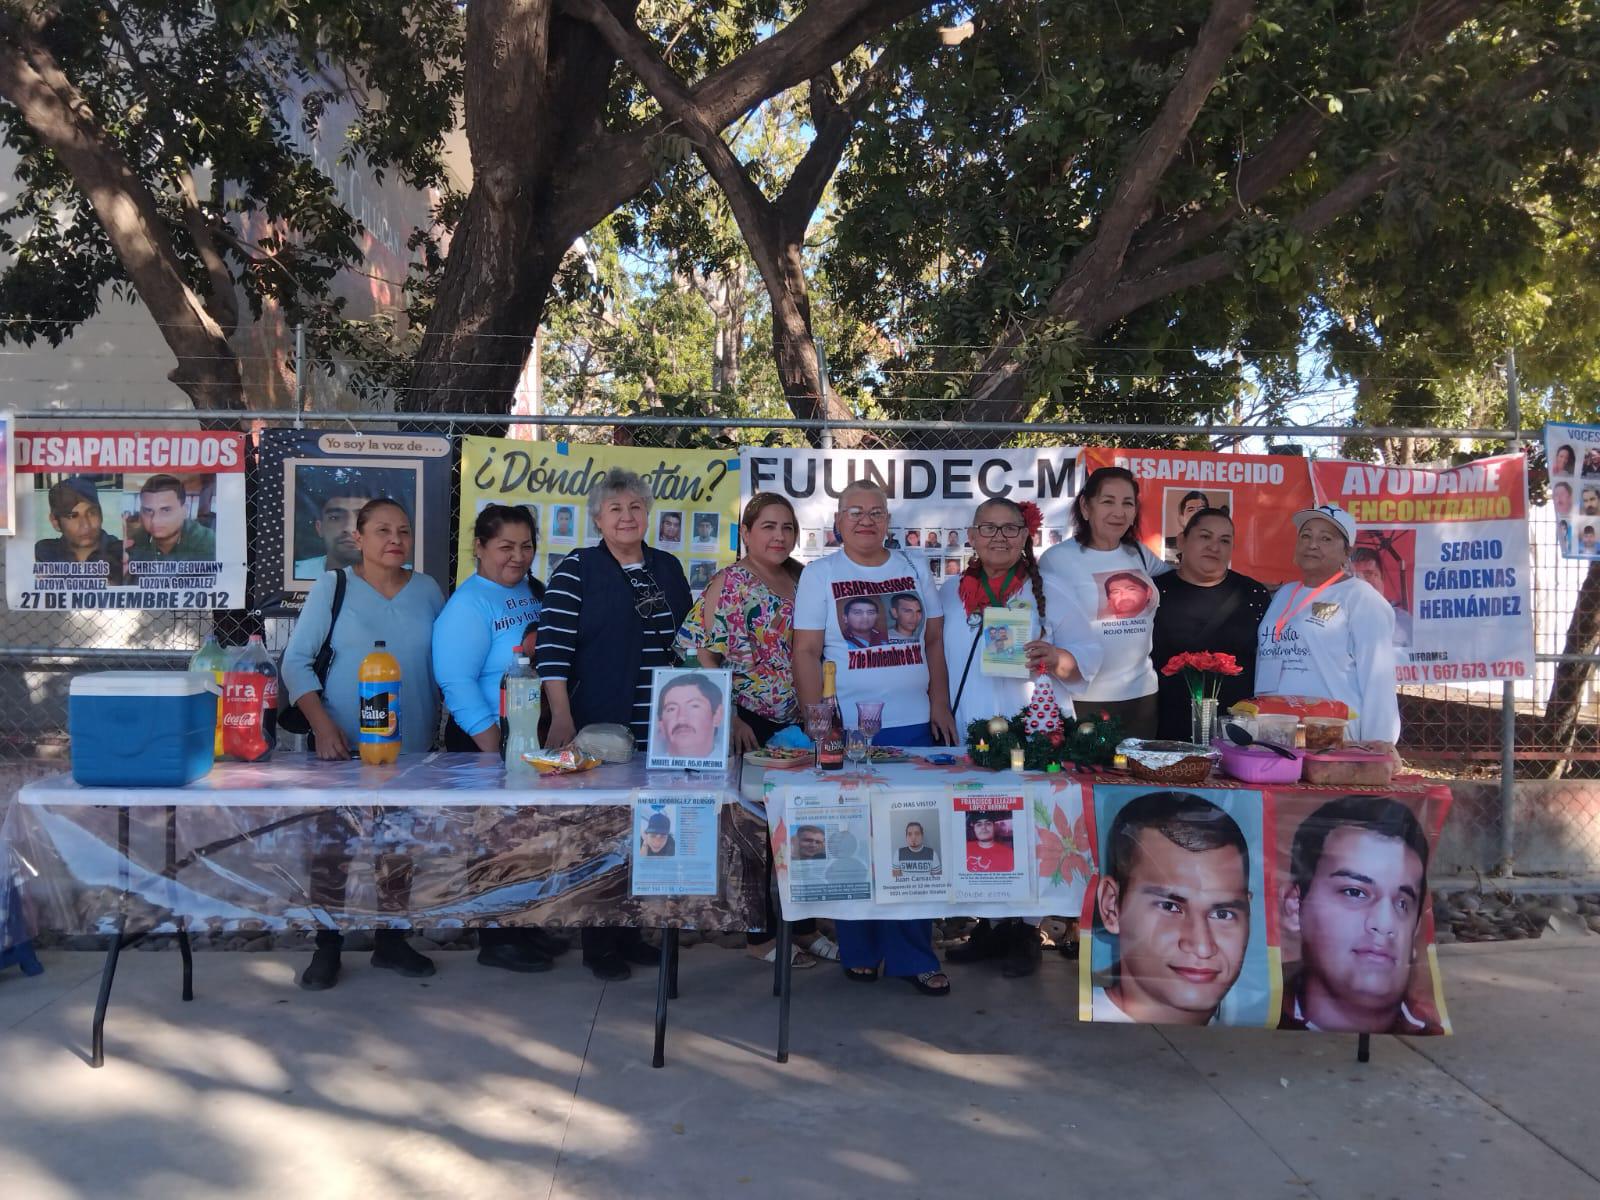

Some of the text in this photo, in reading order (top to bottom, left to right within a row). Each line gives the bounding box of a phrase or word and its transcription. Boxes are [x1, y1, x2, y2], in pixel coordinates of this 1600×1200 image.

[15, 436, 238, 468] DESAPARECIDOS
[326, 438, 340, 449] Yo
[344, 440, 364, 452] soy
[369, 439, 378, 449] la
[383, 441, 403, 450] voz
[407, 440, 422, 451] de
[749, 457, 1090, 500] FUUNDEC-M
[1114, 456, 1284, 485] DESAPARECIDO
[1341, 463, 1501, 496] AYUDAME
[1348, 496, 1511, 522] ENCONTRARLO
[1440, 540, 1503, 562] SERGIO
[33, 560, 109, 575] ANTONIO DE JESÚS
[129, 561, 223, 574] CHRISTIAN GEOVANNY
[34, 578, 107, 590] LOZOYA GONZALEZ
[140, 576, 214, 589] LOZOYA GONZALEZ
[1424, 567, 1516, 591] CÁRDENAS
[21, 592, 230, 609] 27 DE NOVIEMBRE 2012
[518, 598, 529, 607] es
[1419, 594, 1522, 620] HERNÁNDEZ
[494, 616, 516, 632] hijo
[516, 615, 523, 626] y
[523, 611, 535, 622] lo
[1103, 628, 1123, 636] ROJO
[848, 650, 857, 670] 27
[857, 650, 866, 669] de
[867, 646, 906, 668] Noviembre
[1409, 652, 1448, 662] INFORMES
[1421, 664, 1429, 681] Y
[1433, 664, 1459, 680] 667
[1461, 663, 1488, 679] 573
[1490, 661, 1525, 678] 1276
[361, 709, 386, 720] Valle
[687, 759, 702, 767] ROJO
